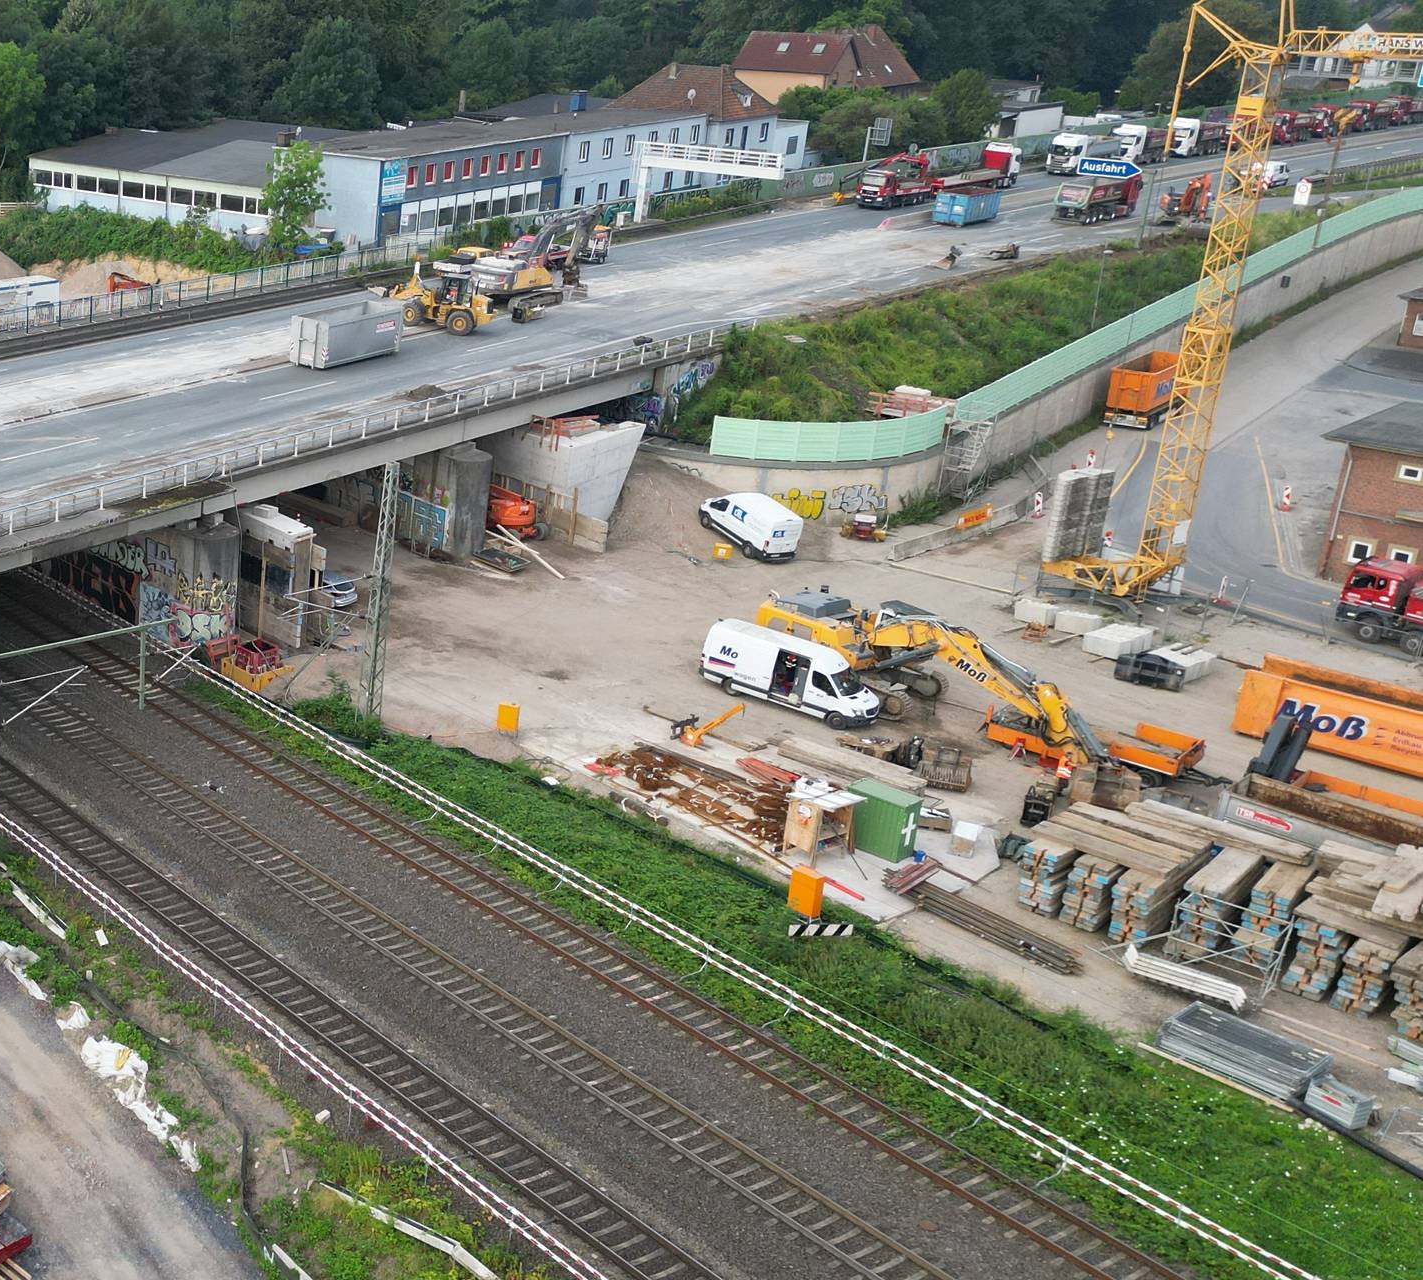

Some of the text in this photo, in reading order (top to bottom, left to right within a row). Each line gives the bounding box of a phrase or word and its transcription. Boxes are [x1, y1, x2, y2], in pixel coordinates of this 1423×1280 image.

[1377, 39, 1411, 48] HANS
[1082, 161, 1127, 174] Ausfahrt
[719, 645, 739, 659] Mo
[955, 658, 988, 683] Moß
[1274, 699, 1367, 741] Moß
